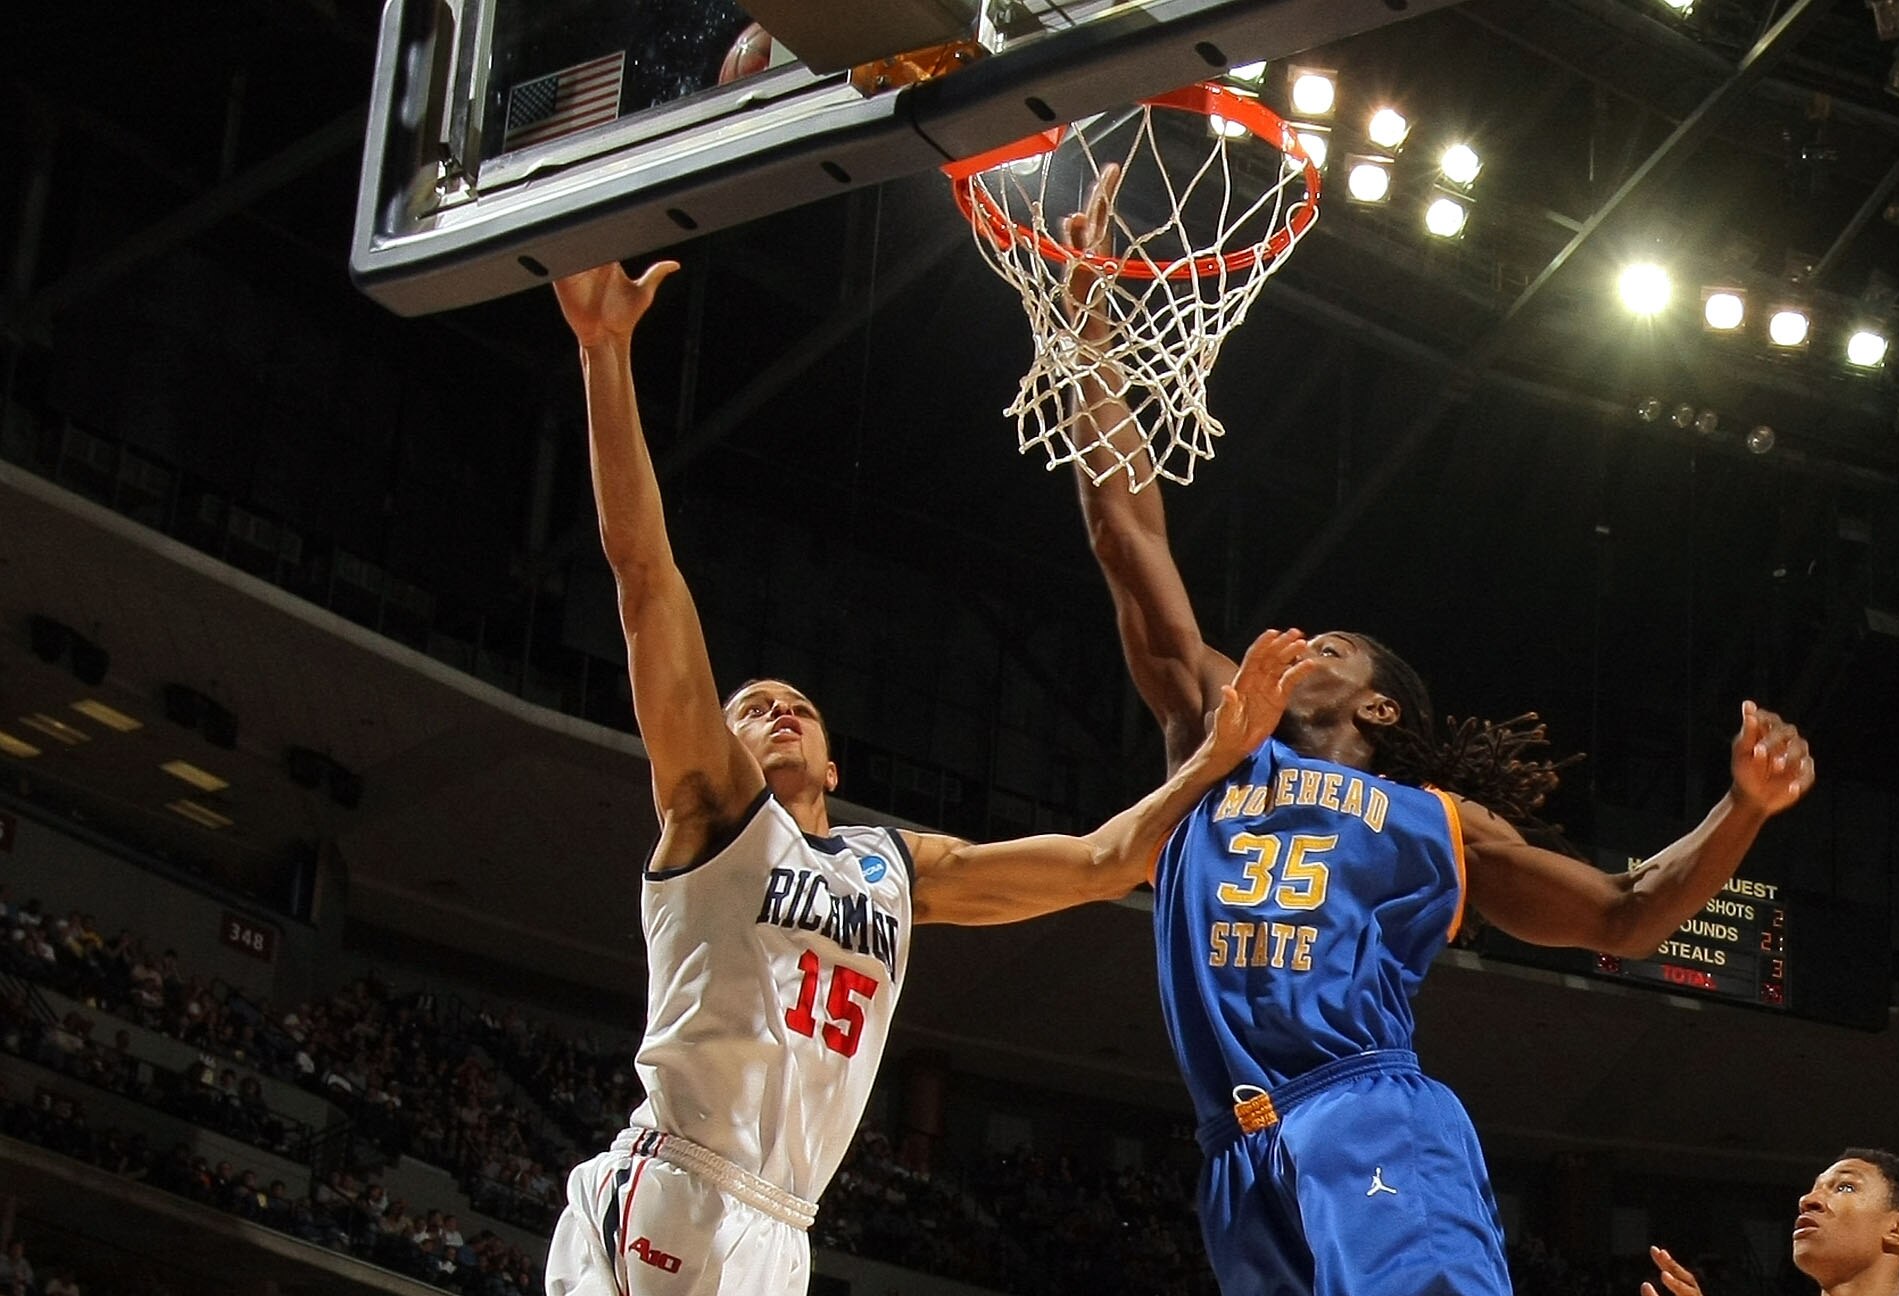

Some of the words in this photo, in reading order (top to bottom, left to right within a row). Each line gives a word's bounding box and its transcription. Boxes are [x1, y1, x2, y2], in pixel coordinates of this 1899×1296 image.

[1213, 768, 1389, 833] MOEHEAD
[1216, 832, 1339, 911] 35
[1705, 898, 1755, 920] SHOTS
[230, 922, 264, 951] 348
[1209, 922, 1318, 970] STATE
[1680, 919, 1739, 942] OUNDS
[1658, 940, 1726, 965] STEALS
[785, 949, 878, 1058] 15
